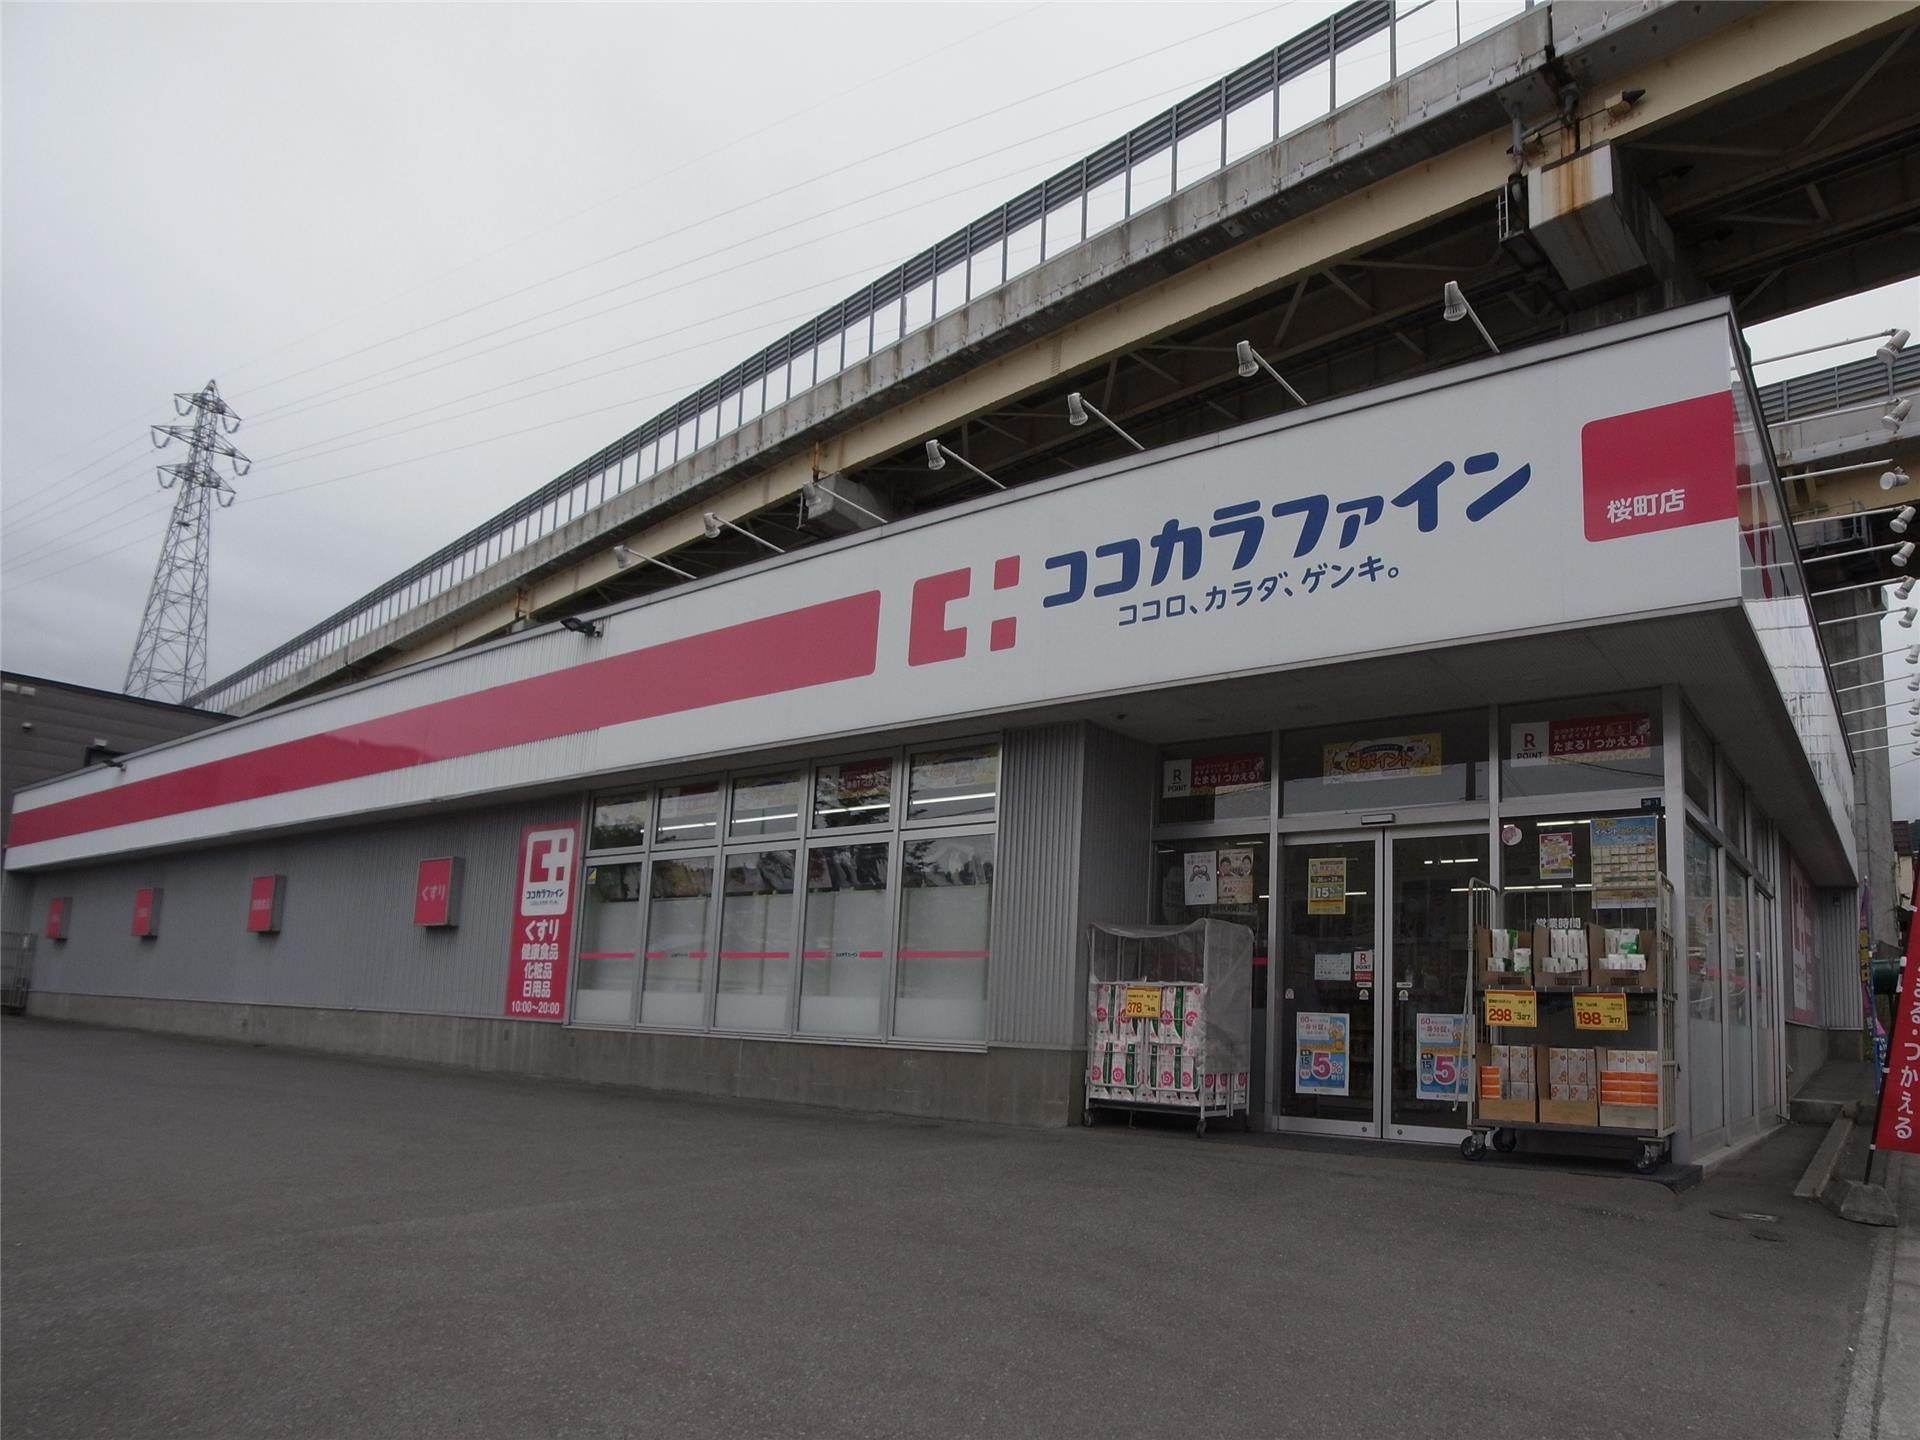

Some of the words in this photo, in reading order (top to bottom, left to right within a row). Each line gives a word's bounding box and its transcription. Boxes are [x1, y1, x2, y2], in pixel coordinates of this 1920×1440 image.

[1607, 489, 1685, 524] 桜町店
[1043, 452, 1531, 608] ココカラファイン
[1118, 555, 1400, 626] ココロ、カラダ、ゲンキ。
[1516, 751, 1544, 760] POINT
[422, 885, 446, 902] くすり
[526, 888, 565, 900] ココカラファイン
[525, 919, 560, 941] くすり
[521, 943, 559, 960] 健康食品
[524, 962, 552, 979] 化粧品
[523, 980, 551, 998] 日用品
[1127, 1001, 1143, 1013] 378
[1488, 1008, 1513, 1023] 298
[1577, 1011, 1602, 1026] 198
